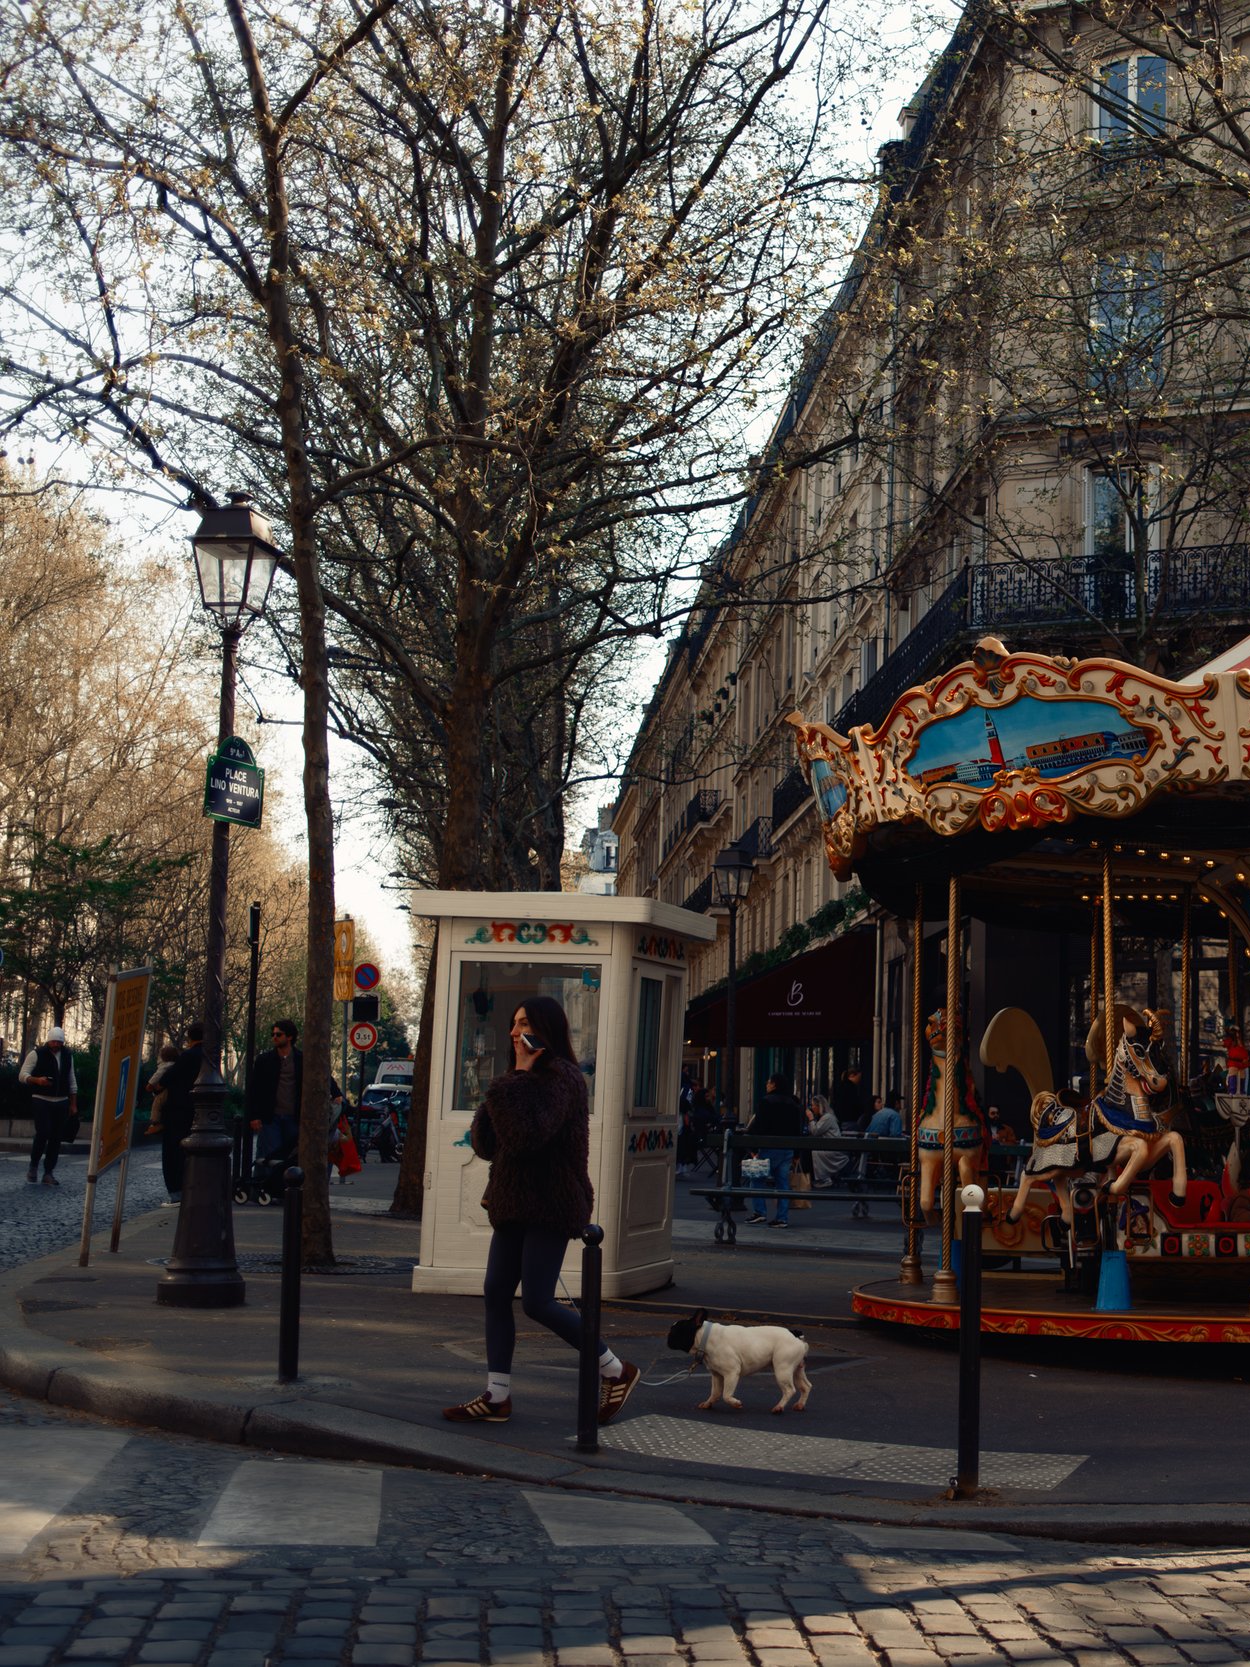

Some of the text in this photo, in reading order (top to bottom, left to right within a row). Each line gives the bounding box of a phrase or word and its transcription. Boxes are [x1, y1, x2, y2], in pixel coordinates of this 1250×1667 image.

[225, 767, 247, 783] PLACE
[210, 777, 260, 800] LINO VENTURA
[787, 980, 804, 1007] B
